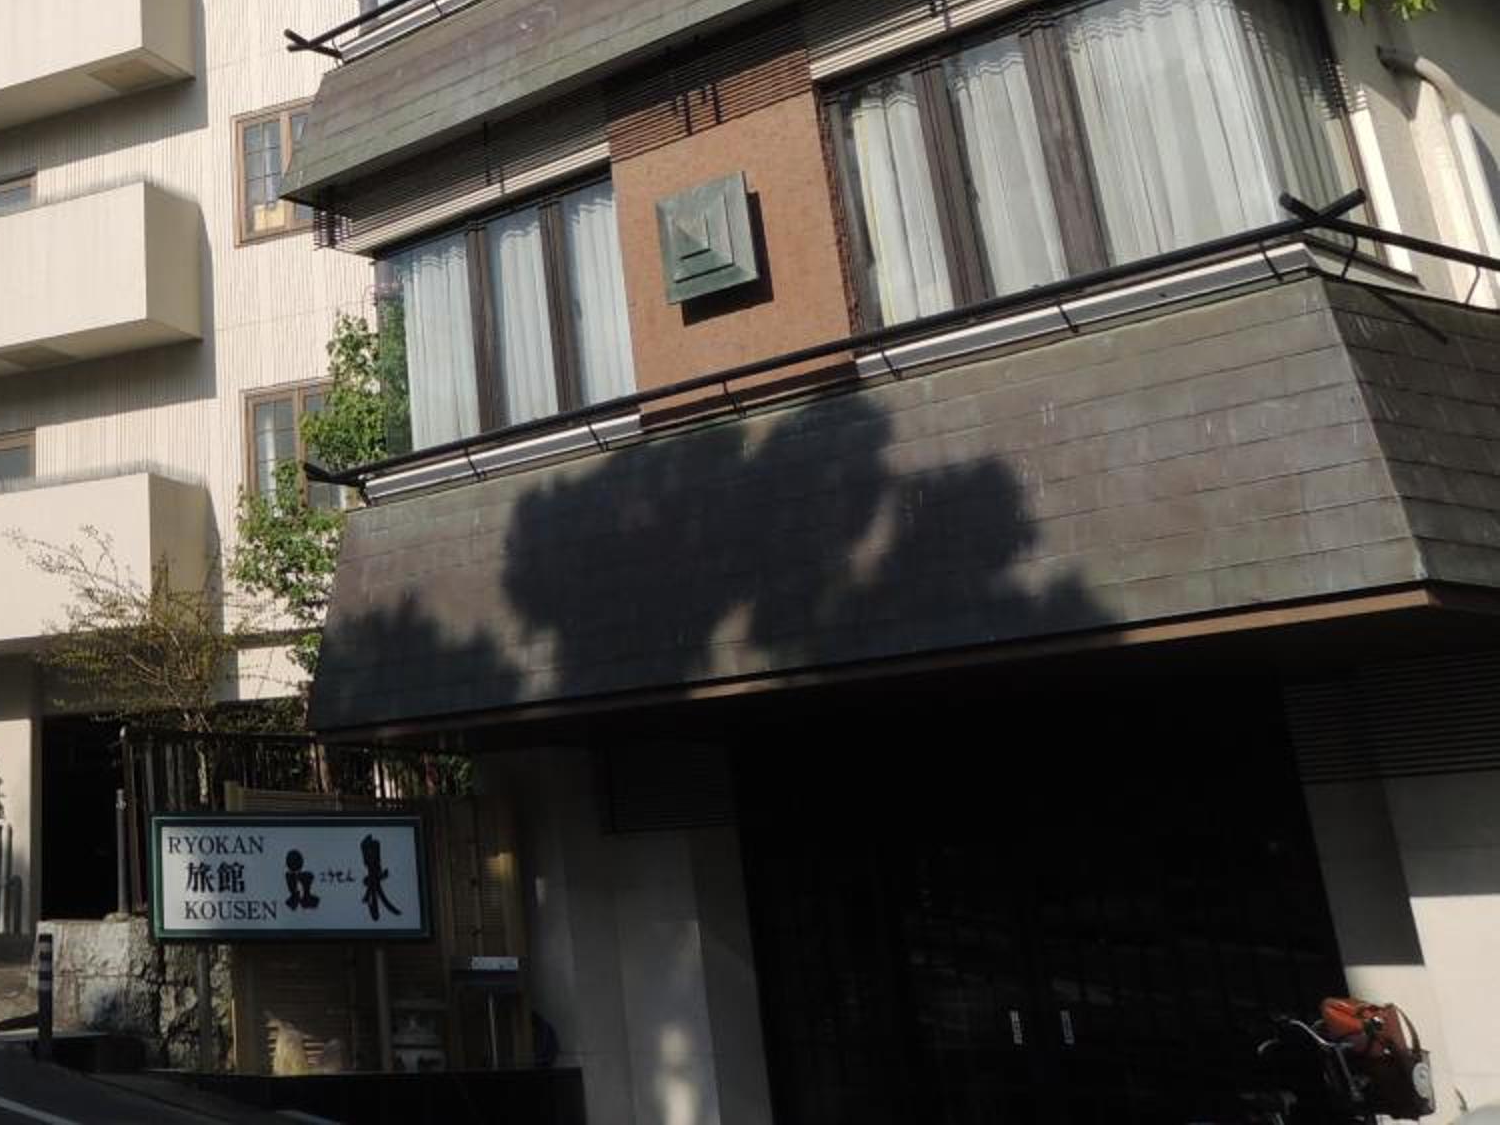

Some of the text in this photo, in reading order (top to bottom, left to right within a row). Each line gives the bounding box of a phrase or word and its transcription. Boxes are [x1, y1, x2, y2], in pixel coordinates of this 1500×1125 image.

[168, 835, 264, 855] RYOKAN
[186, 862, 245, 893] 旅館
[185, 900, 277, 921] KOUSEN
